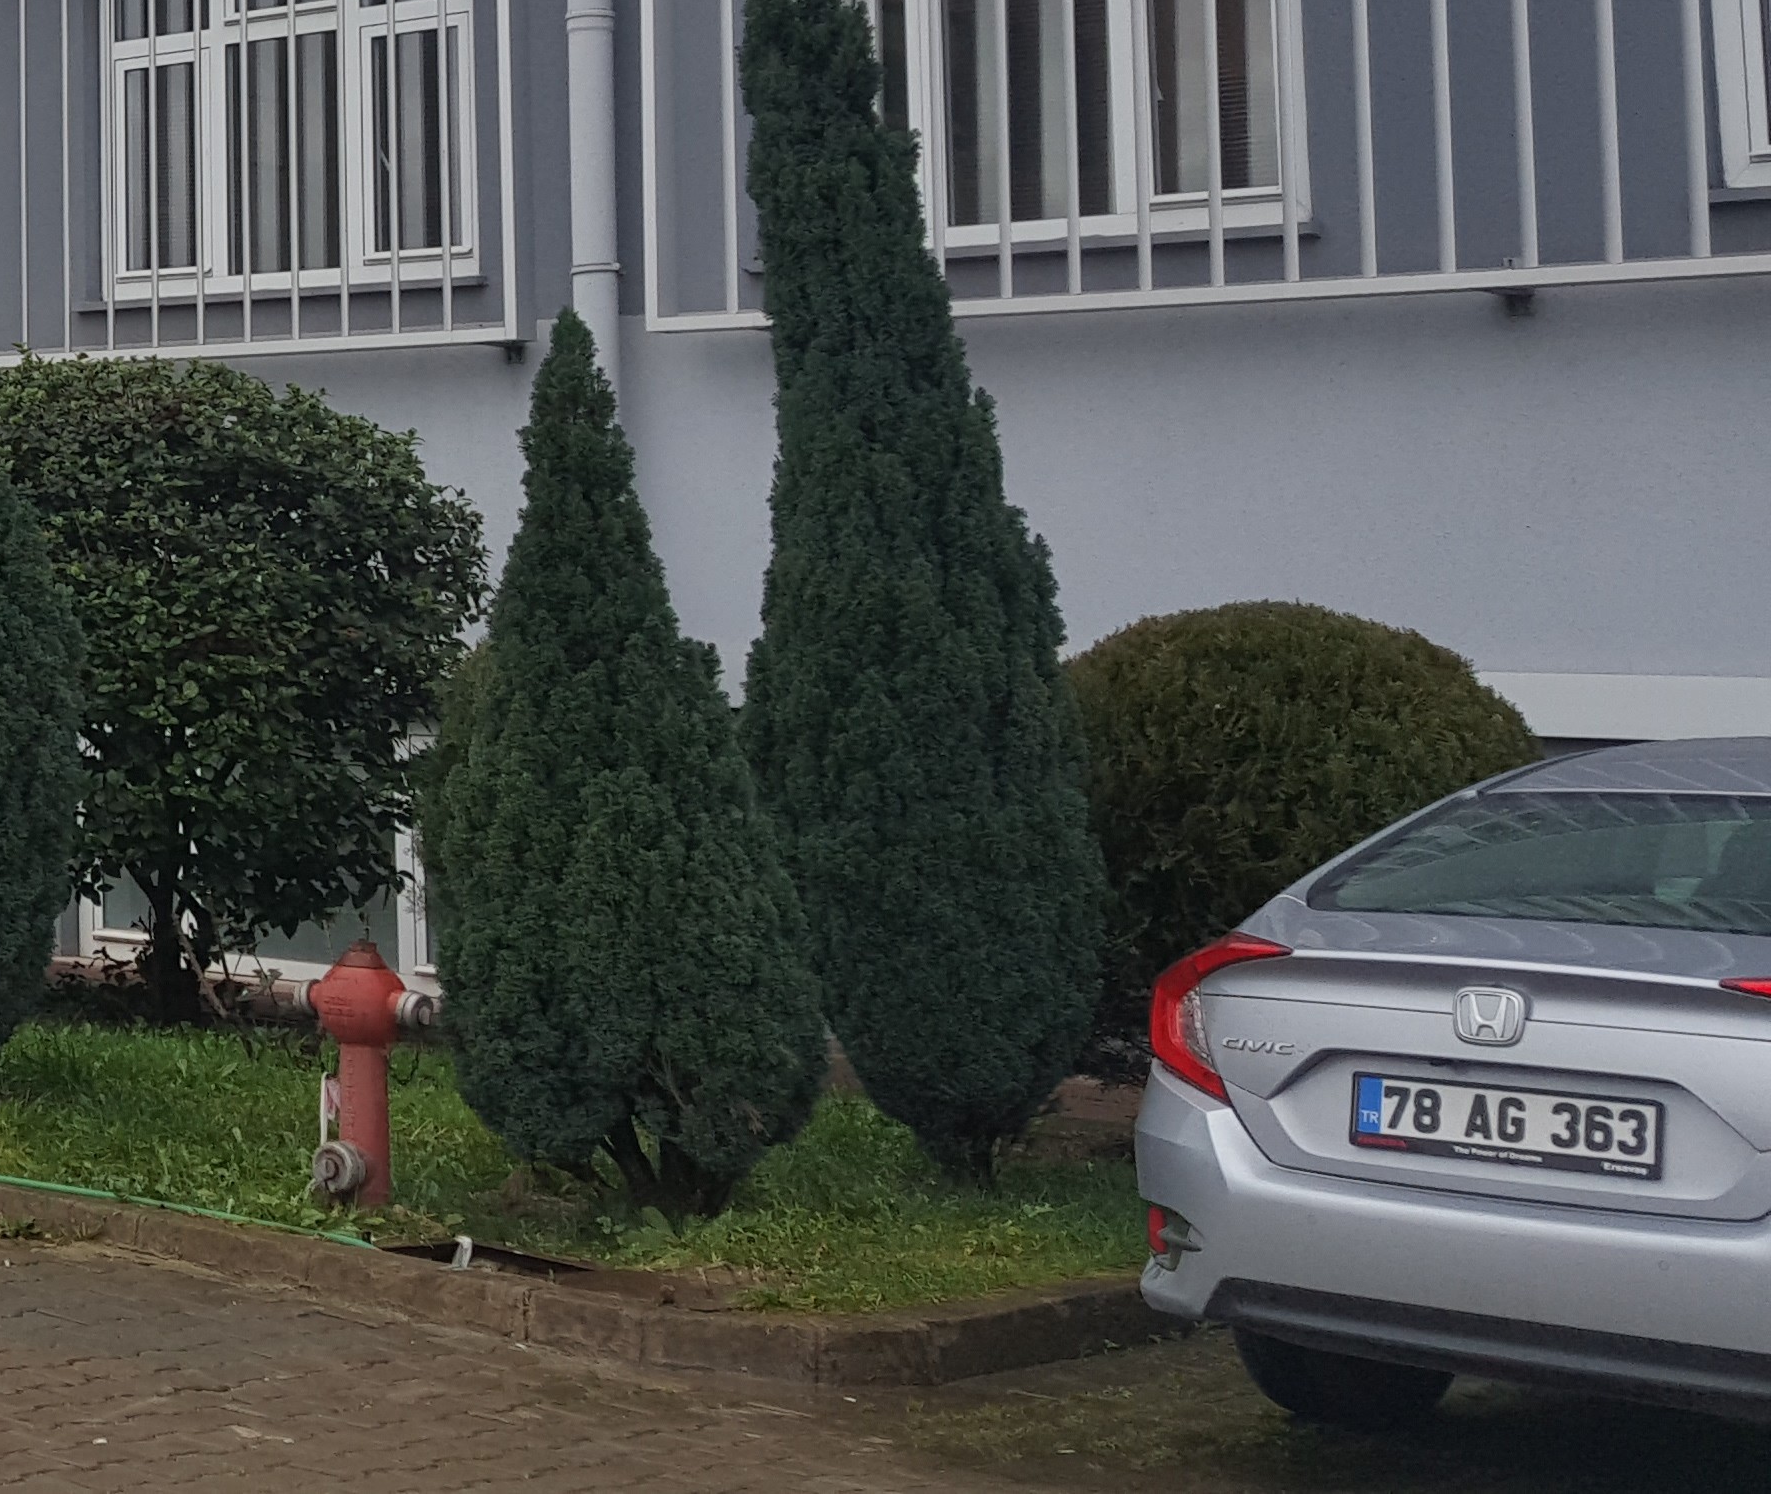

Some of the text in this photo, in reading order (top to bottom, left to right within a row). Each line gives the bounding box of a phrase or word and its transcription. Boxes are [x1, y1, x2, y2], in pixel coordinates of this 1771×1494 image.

[1222, 1037, 1295, 1055] CIVIC
[1361, 1109, 1379, 1124] TR
[1384, 1085, 1649, 1156] 78 AG 363
